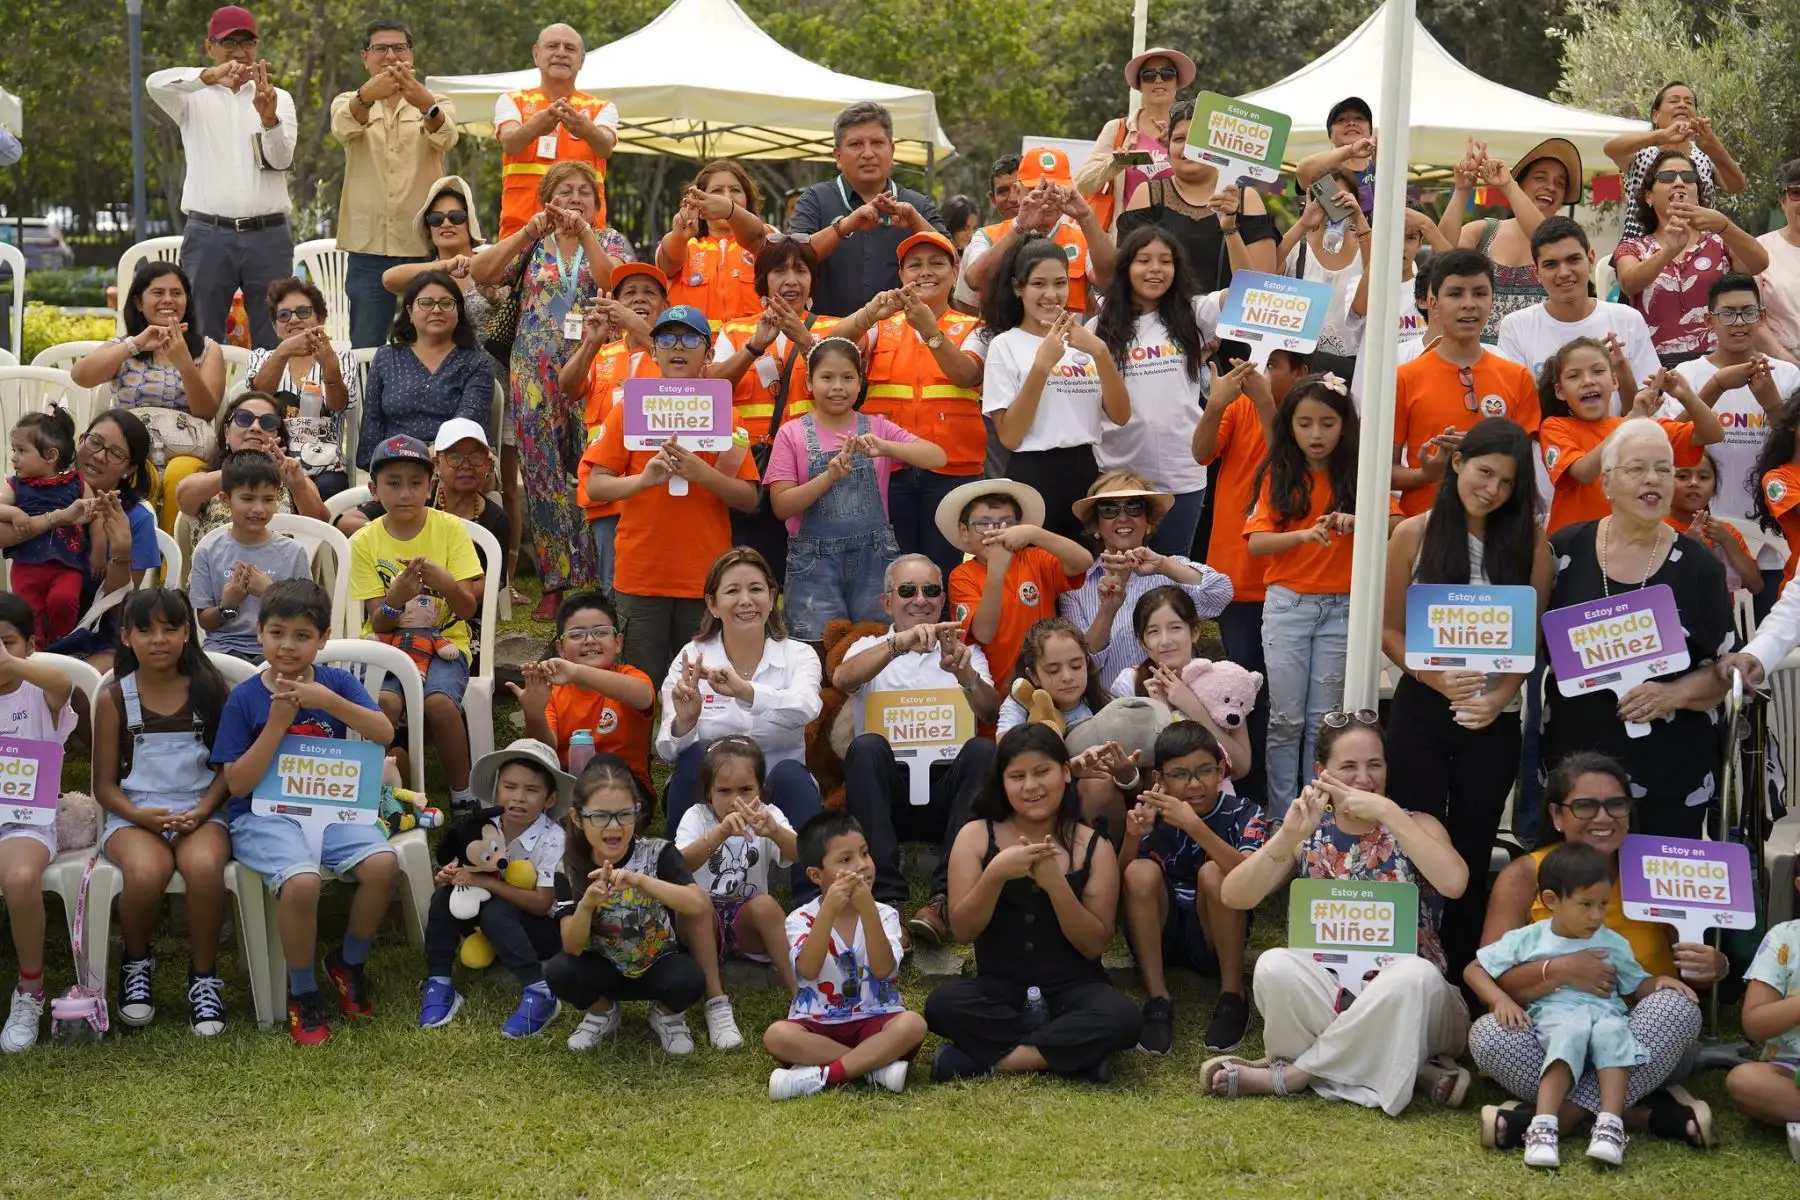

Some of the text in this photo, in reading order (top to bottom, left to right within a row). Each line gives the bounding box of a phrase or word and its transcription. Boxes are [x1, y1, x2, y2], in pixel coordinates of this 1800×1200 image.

[1228, 105, 1249, 117] Estoy
[1211, 114, 1269, 140] #Modo
[1213, 130, 1265, 157] Niñez
[1264, 280, 1286, 291] Estoy
[1246, 290, 1307, 312] #Modo
[1246, 307, 1302, 329] Niñez
[659, 385, 683, 394] Estoy
[644, 396, 711, 412] #Modo
[651, 413, 710, 429] Niñez
[1448, 592, 1476, 603] Estoy
[1431, 607, 1510, 624] #Modo
[1584, 603, 1629, 620] Estoy en
[1439, 626, 1508, 645] Niñez
[1572, 614, 1653, 647] #Modo
[1585, 634, 1657, 665] Niñez
[900, 696, 924, 704] Estoy
[886, 706, 953, 723] #Modo
[893, 723, 952, 740] Niñez
[299, 743, 342, 755] Estoy en
[281, 756, 358, 778] #Modo
[287, 776, 355, 798] Niñez
[1661, 845, 1690, 856] Estoy
[1645, 858, 1726, 880] #Modo
[1331, 887, 1374, 898] Estoy en
[1656, 878, 1726, 900] Niñez
[1314, 902, 1392, 921] #Modo
[1321, 922, 1390, 942] Niñez
